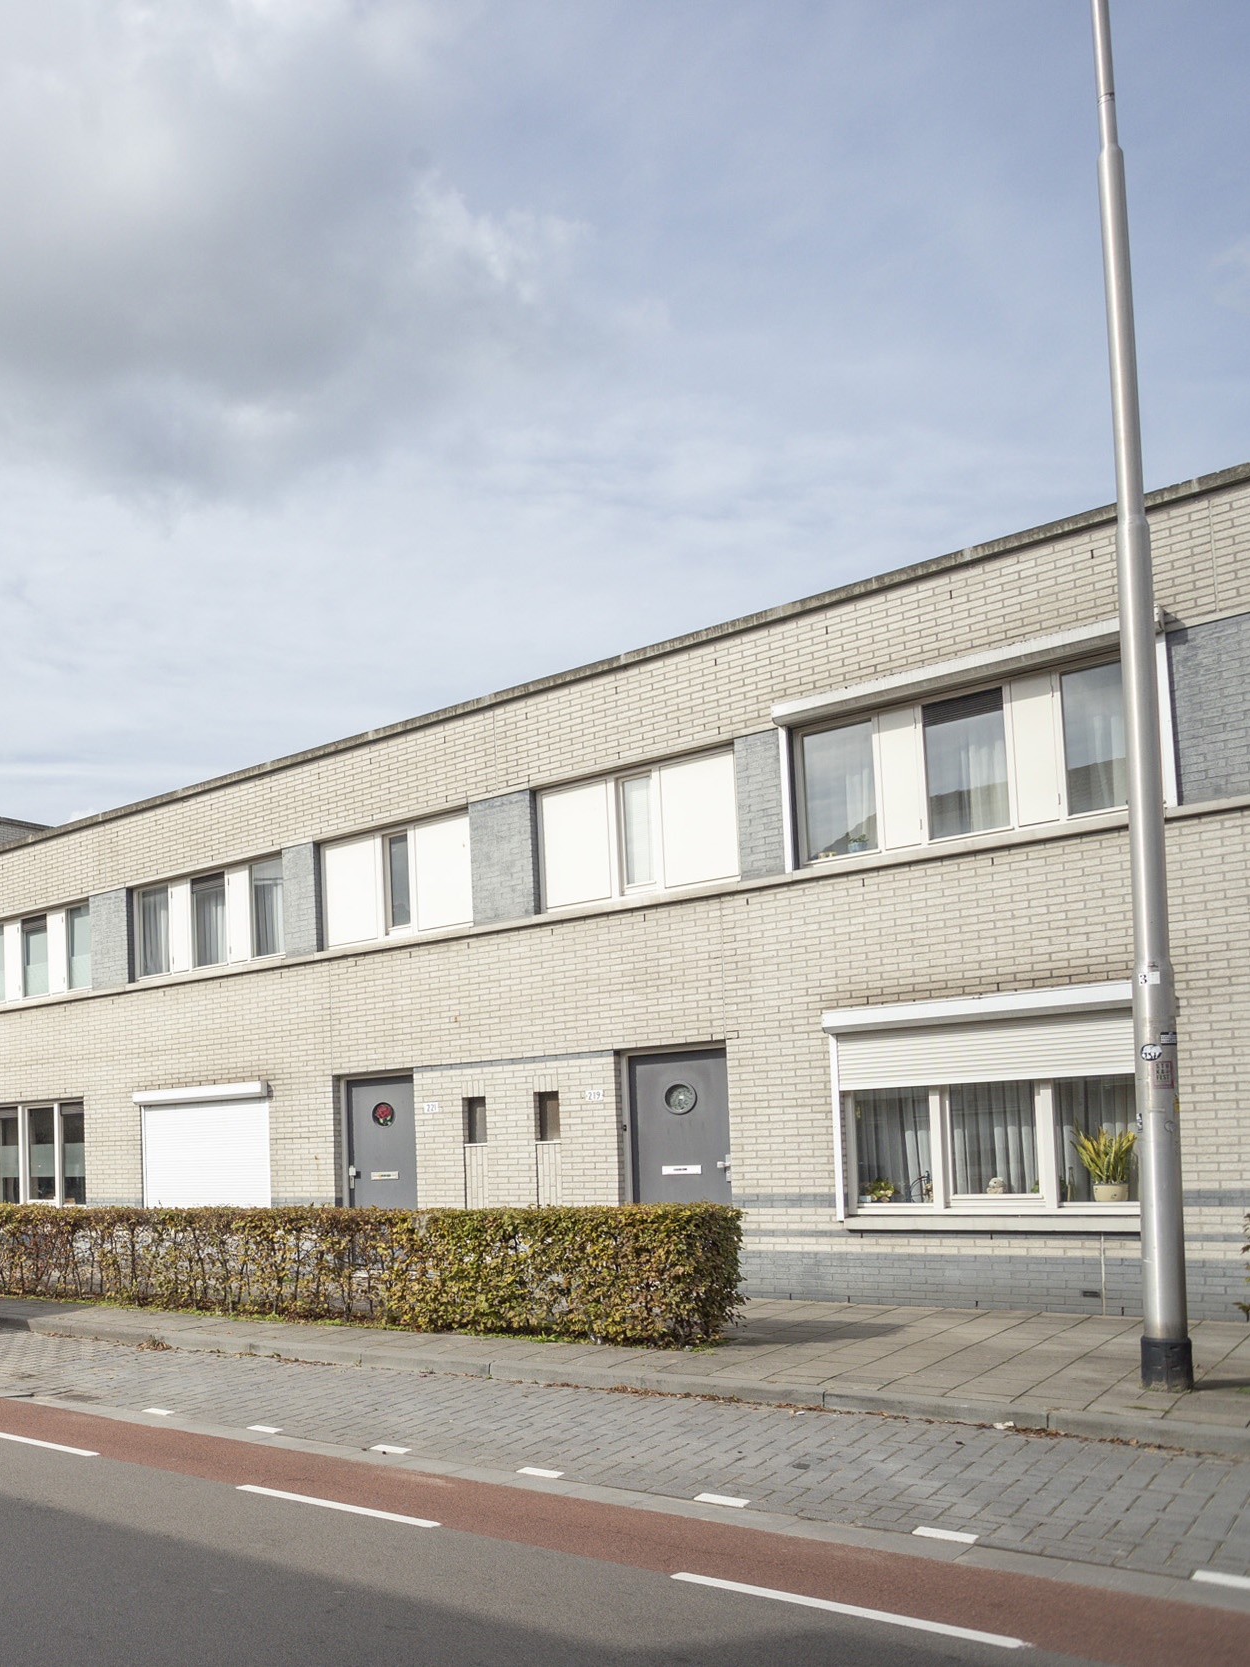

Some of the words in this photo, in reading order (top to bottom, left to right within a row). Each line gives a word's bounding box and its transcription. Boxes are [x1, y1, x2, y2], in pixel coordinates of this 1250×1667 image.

[1139, 974, 1148, 984] 3
[588, 1091, 601, 1101] 219
[426, 1103, 437, 1112] 221
